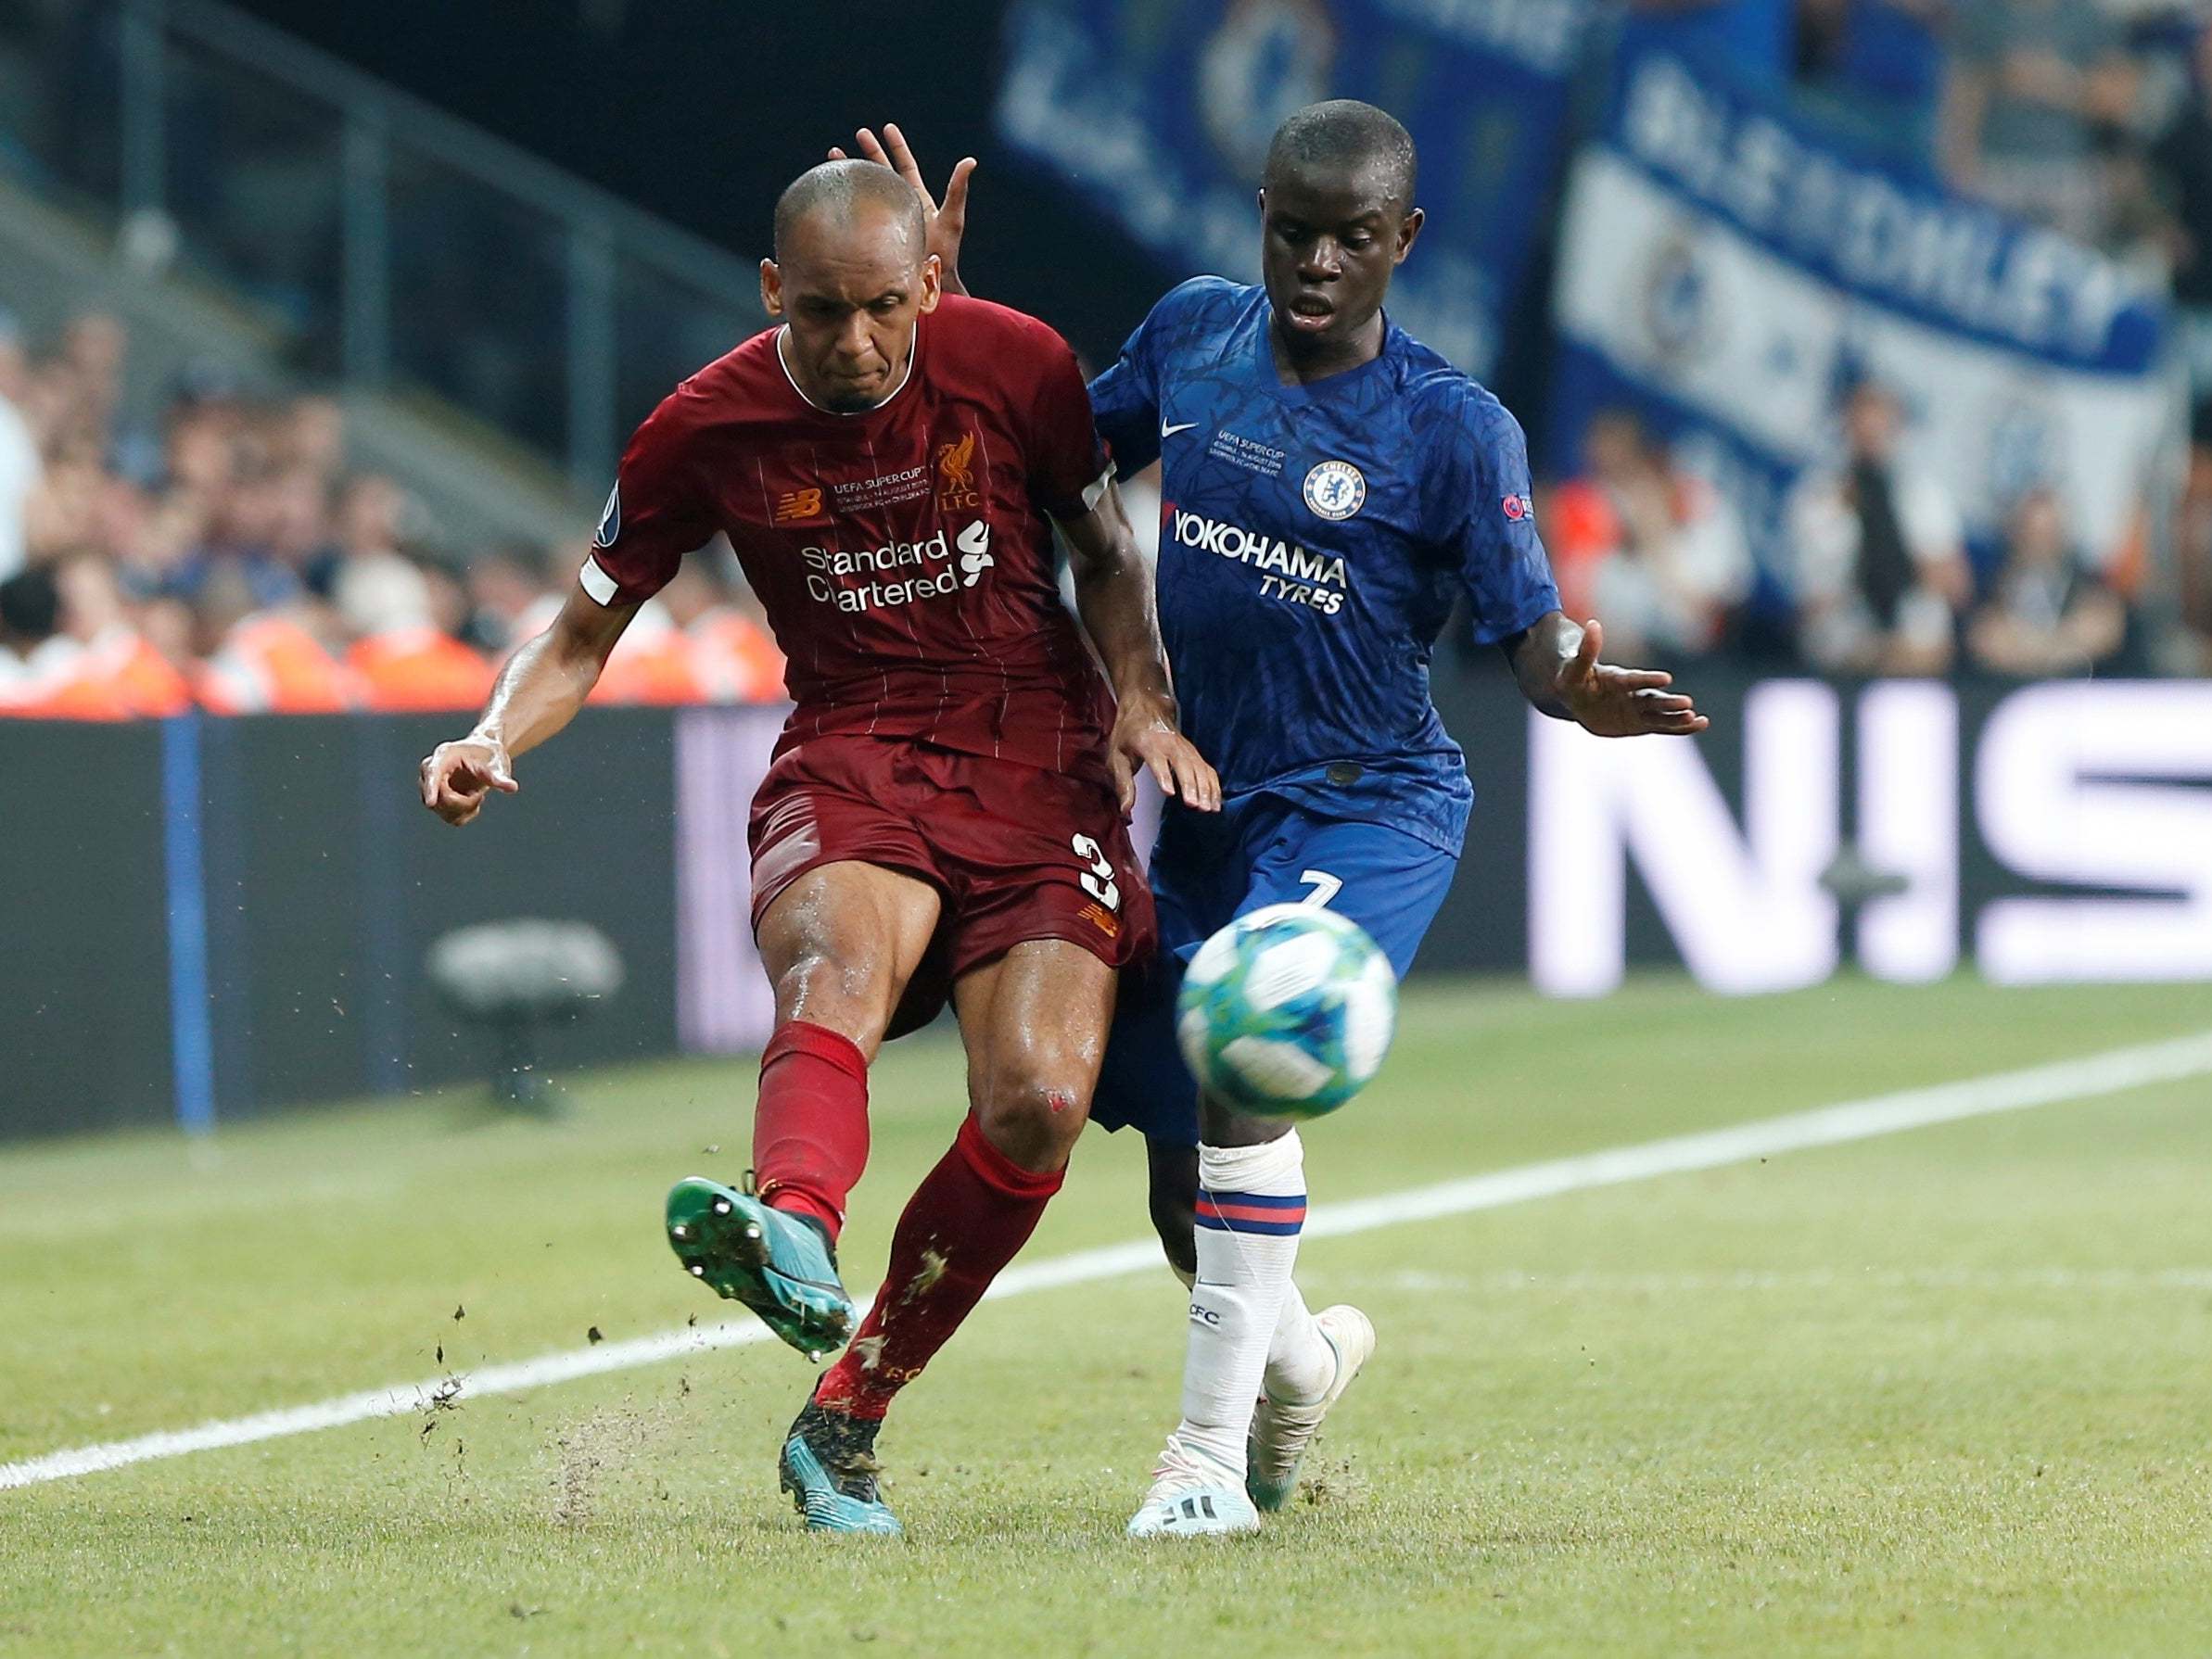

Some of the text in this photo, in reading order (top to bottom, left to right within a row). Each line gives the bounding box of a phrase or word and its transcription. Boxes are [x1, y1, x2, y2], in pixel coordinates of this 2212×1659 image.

[1218, 430, 1239, 446] UEFA
[1239, 438, 1266, 455] SUPER
[1265, 448, 1285, 460] CUP
[833, 467, 921, 494] UEFA SUPER CUP
[942, 492, 980, 511] LFC
[801, 529, 949, 576] Standard
[1175, 509, 1347, 589] YOKOHAMA
[1259, 575, 1344, 614] TYRES
[1527, 678, 2212, 999] NIS
[1072, 832, 1121, 913] 3
[1300, 869, 1343, 911] 7
[1189, 1303, 1220, 1325] CFC
